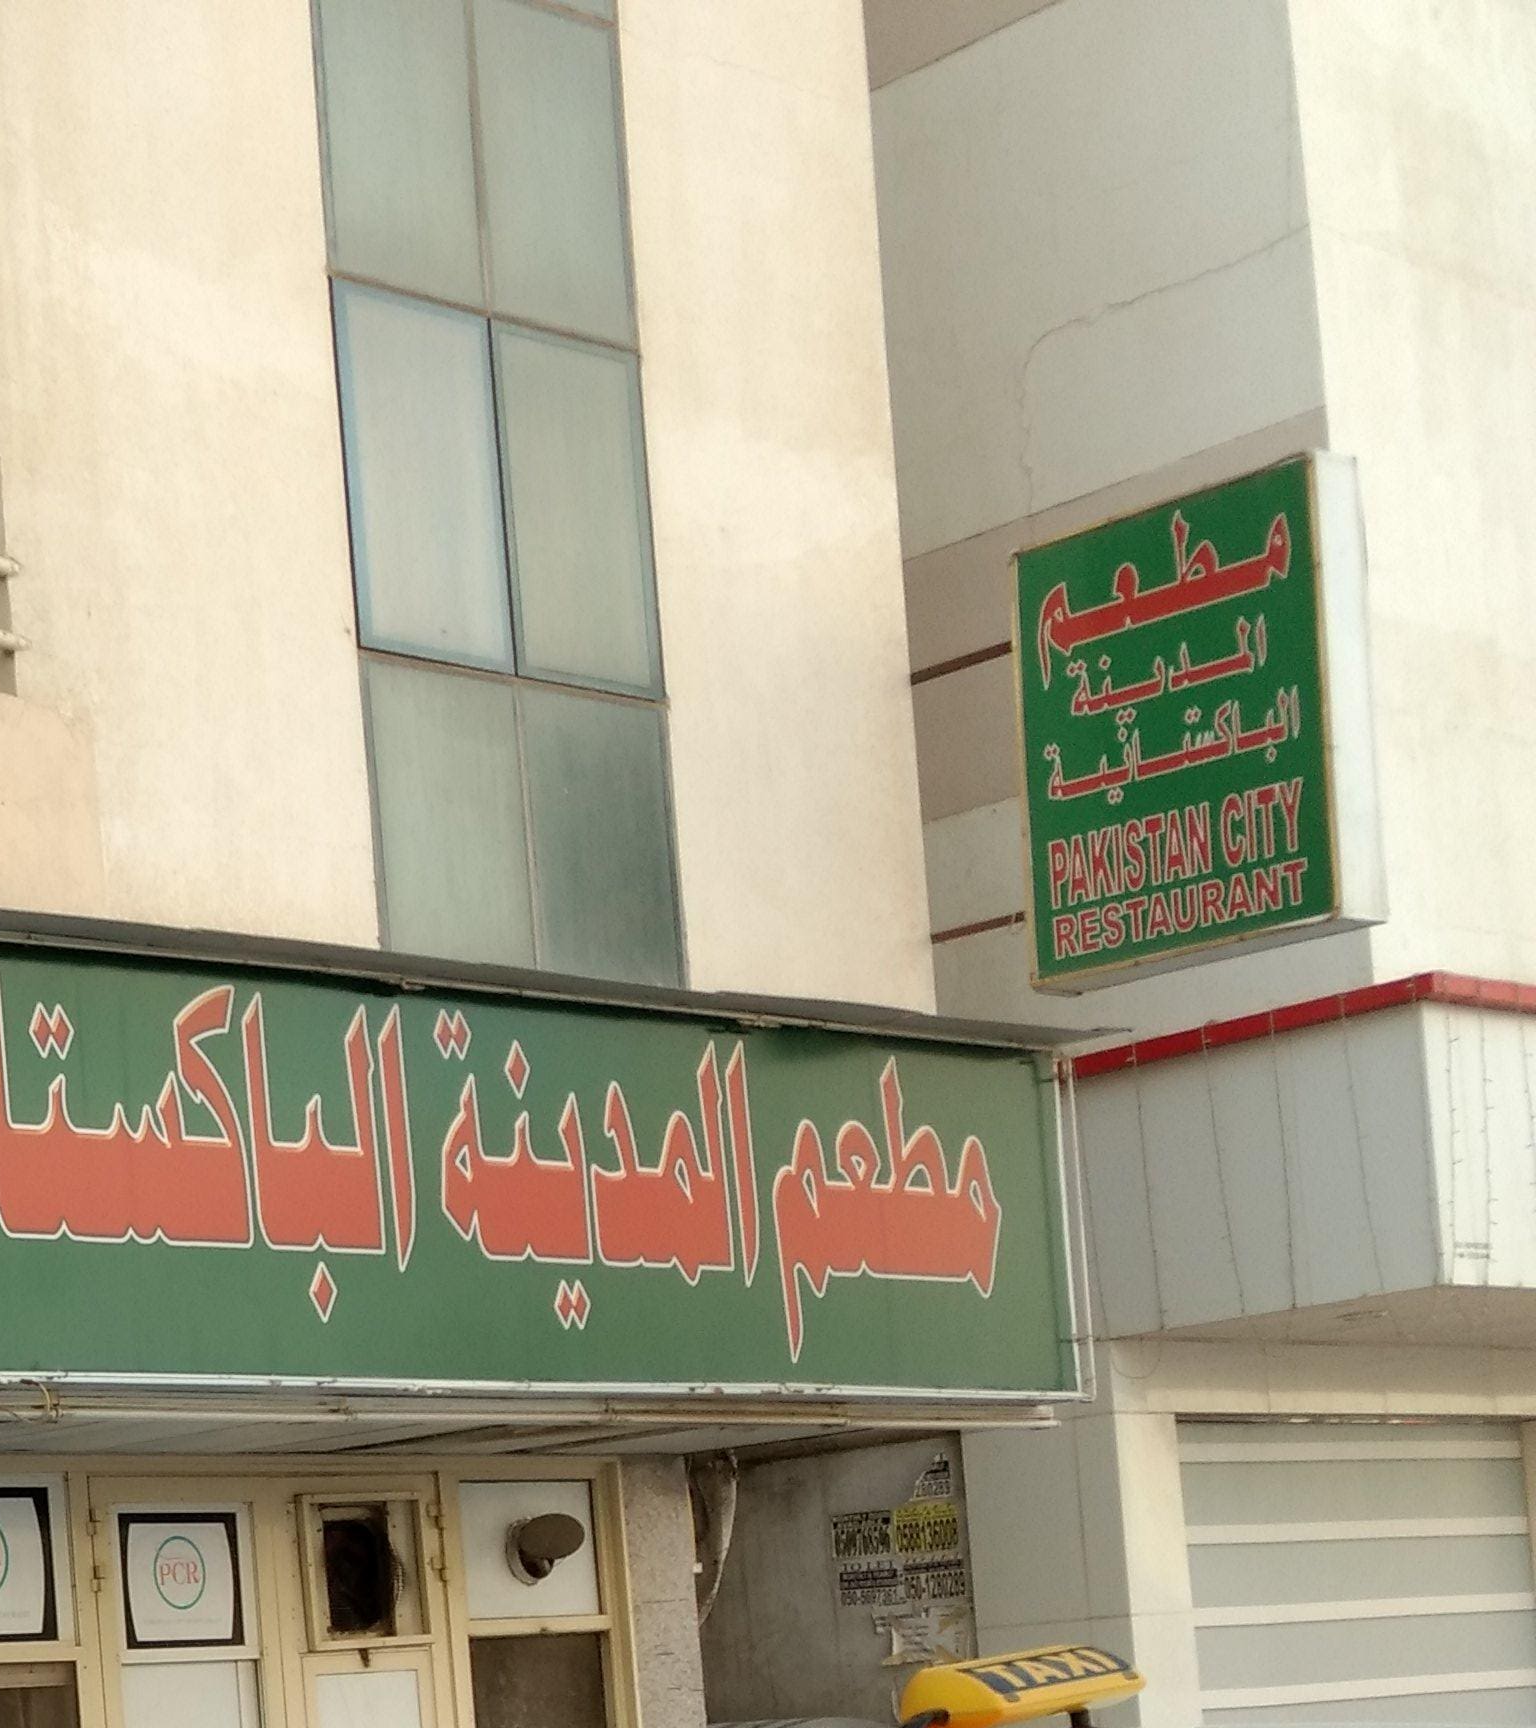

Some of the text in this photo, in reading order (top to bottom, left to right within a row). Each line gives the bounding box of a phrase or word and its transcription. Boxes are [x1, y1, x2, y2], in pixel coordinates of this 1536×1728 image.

[1038, 510, 1292, 691] مطعم
[1066, 613, 1268, 726] المدينة
[1043, 685, 1301, 805] الباكستانية
[1047, 777, 1304, 909] PAKISTAN CITY
[1053, 858, 1308, 961] RESTAURANT
[434, 1007, 760, 1331] المدينة
[773, 1055, 1002, 1363] مطعم
[158, 1560, 200, 1586] PCR
[971, 1649, 1121, 1688] TAXI
